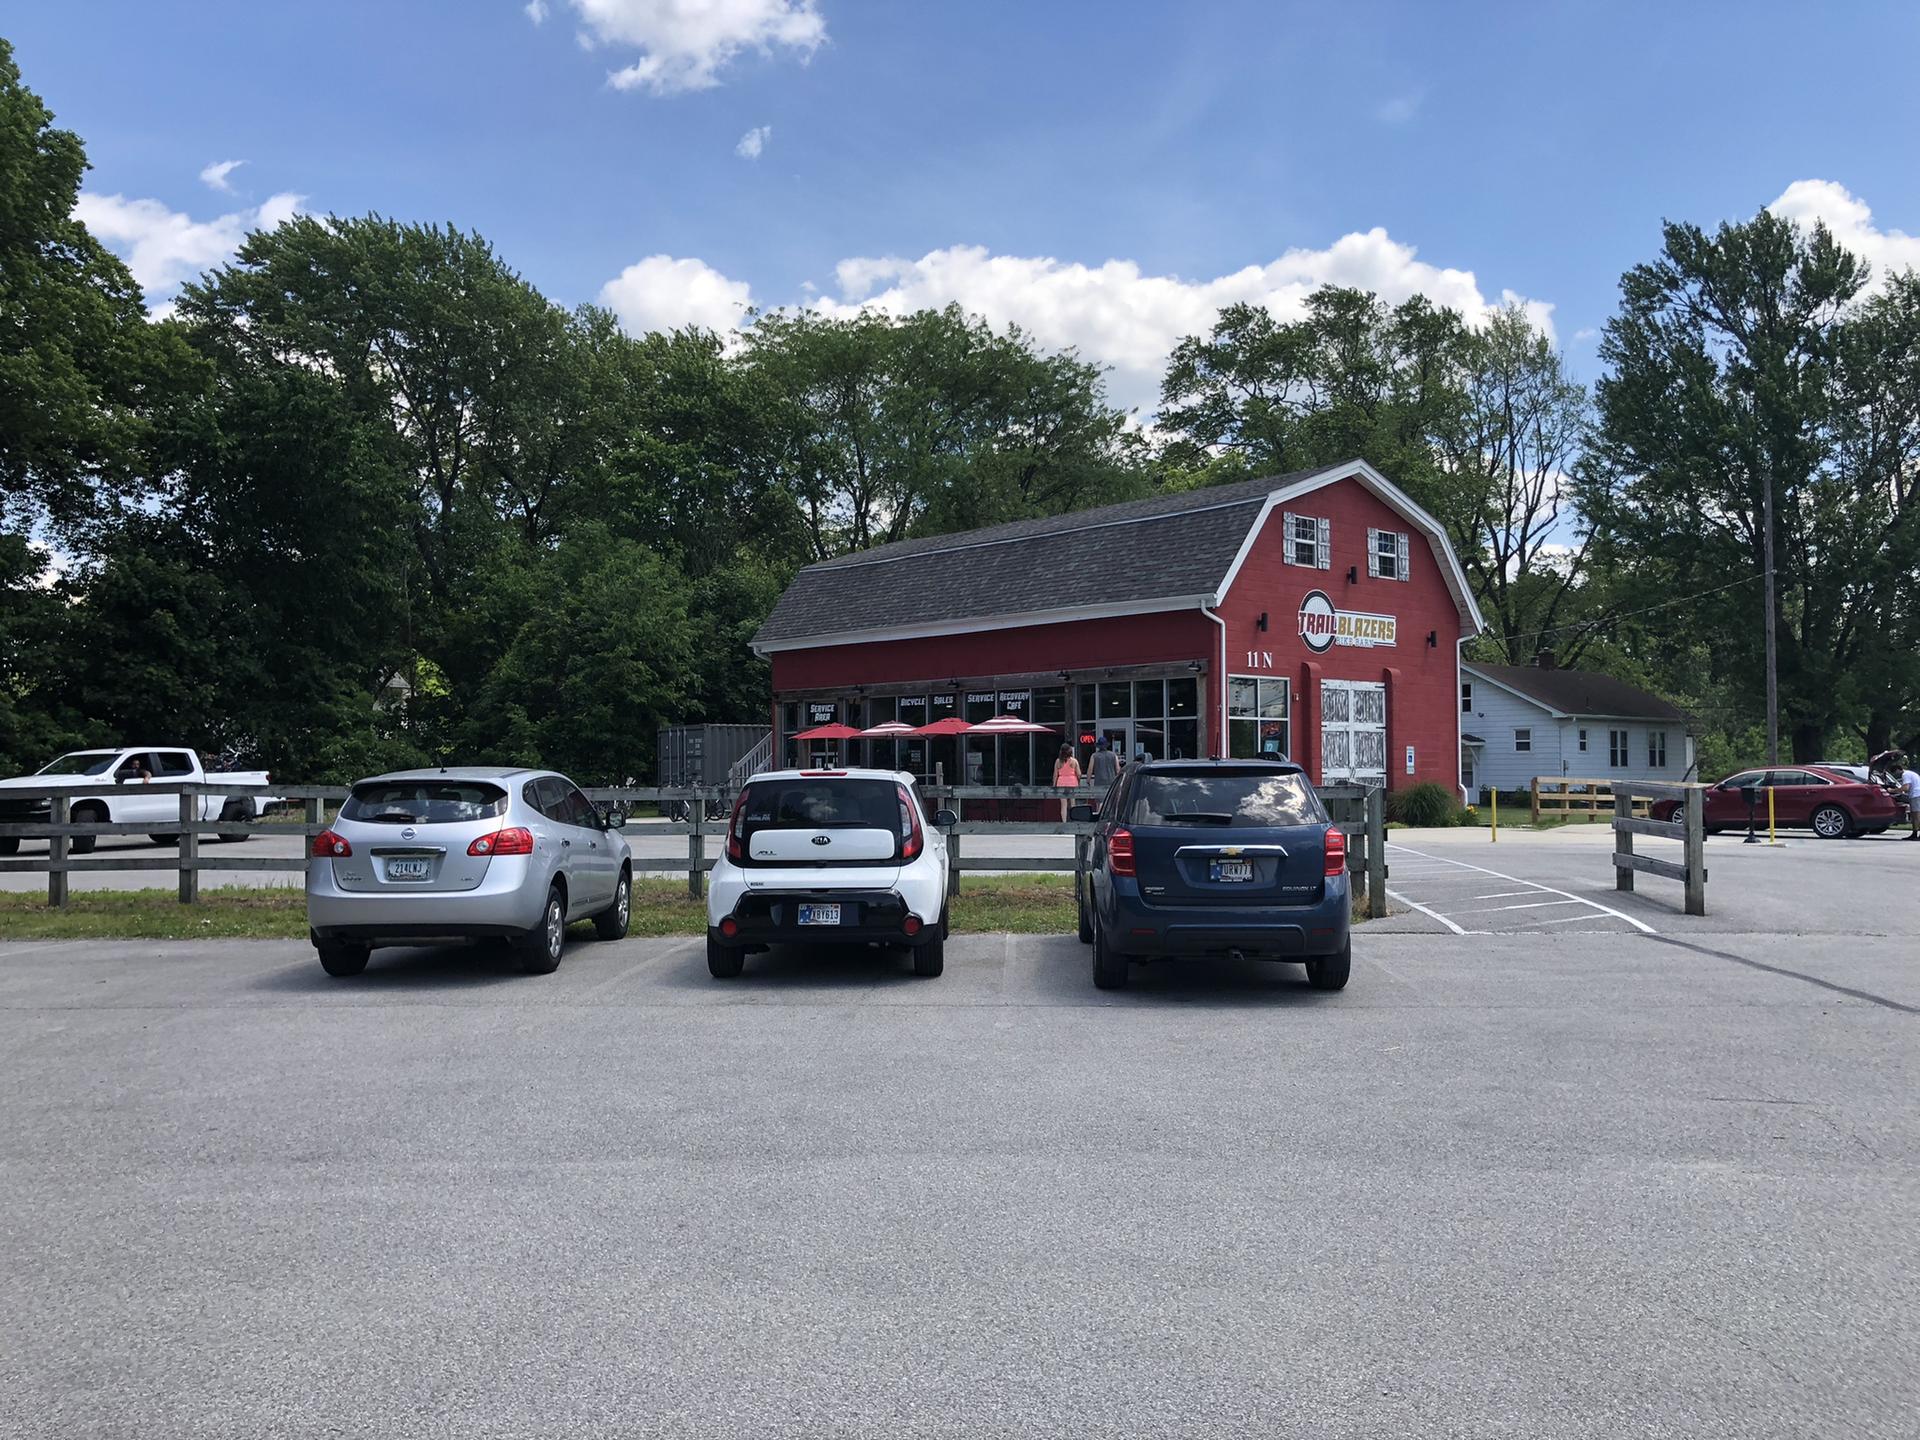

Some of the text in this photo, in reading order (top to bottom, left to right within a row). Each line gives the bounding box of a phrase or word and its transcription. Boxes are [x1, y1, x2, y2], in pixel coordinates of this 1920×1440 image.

[1247, 651, 1273, 669] 11 N
[901, 696, 953, 706] BICYCLE SALES
[968, 694, 995, 703] SERVICE
[1000, 692, 1030, 701] RECOVERY
[810, 704, 835, 713] SERVICE
[1080, 735, 1095, 744] OPEN
